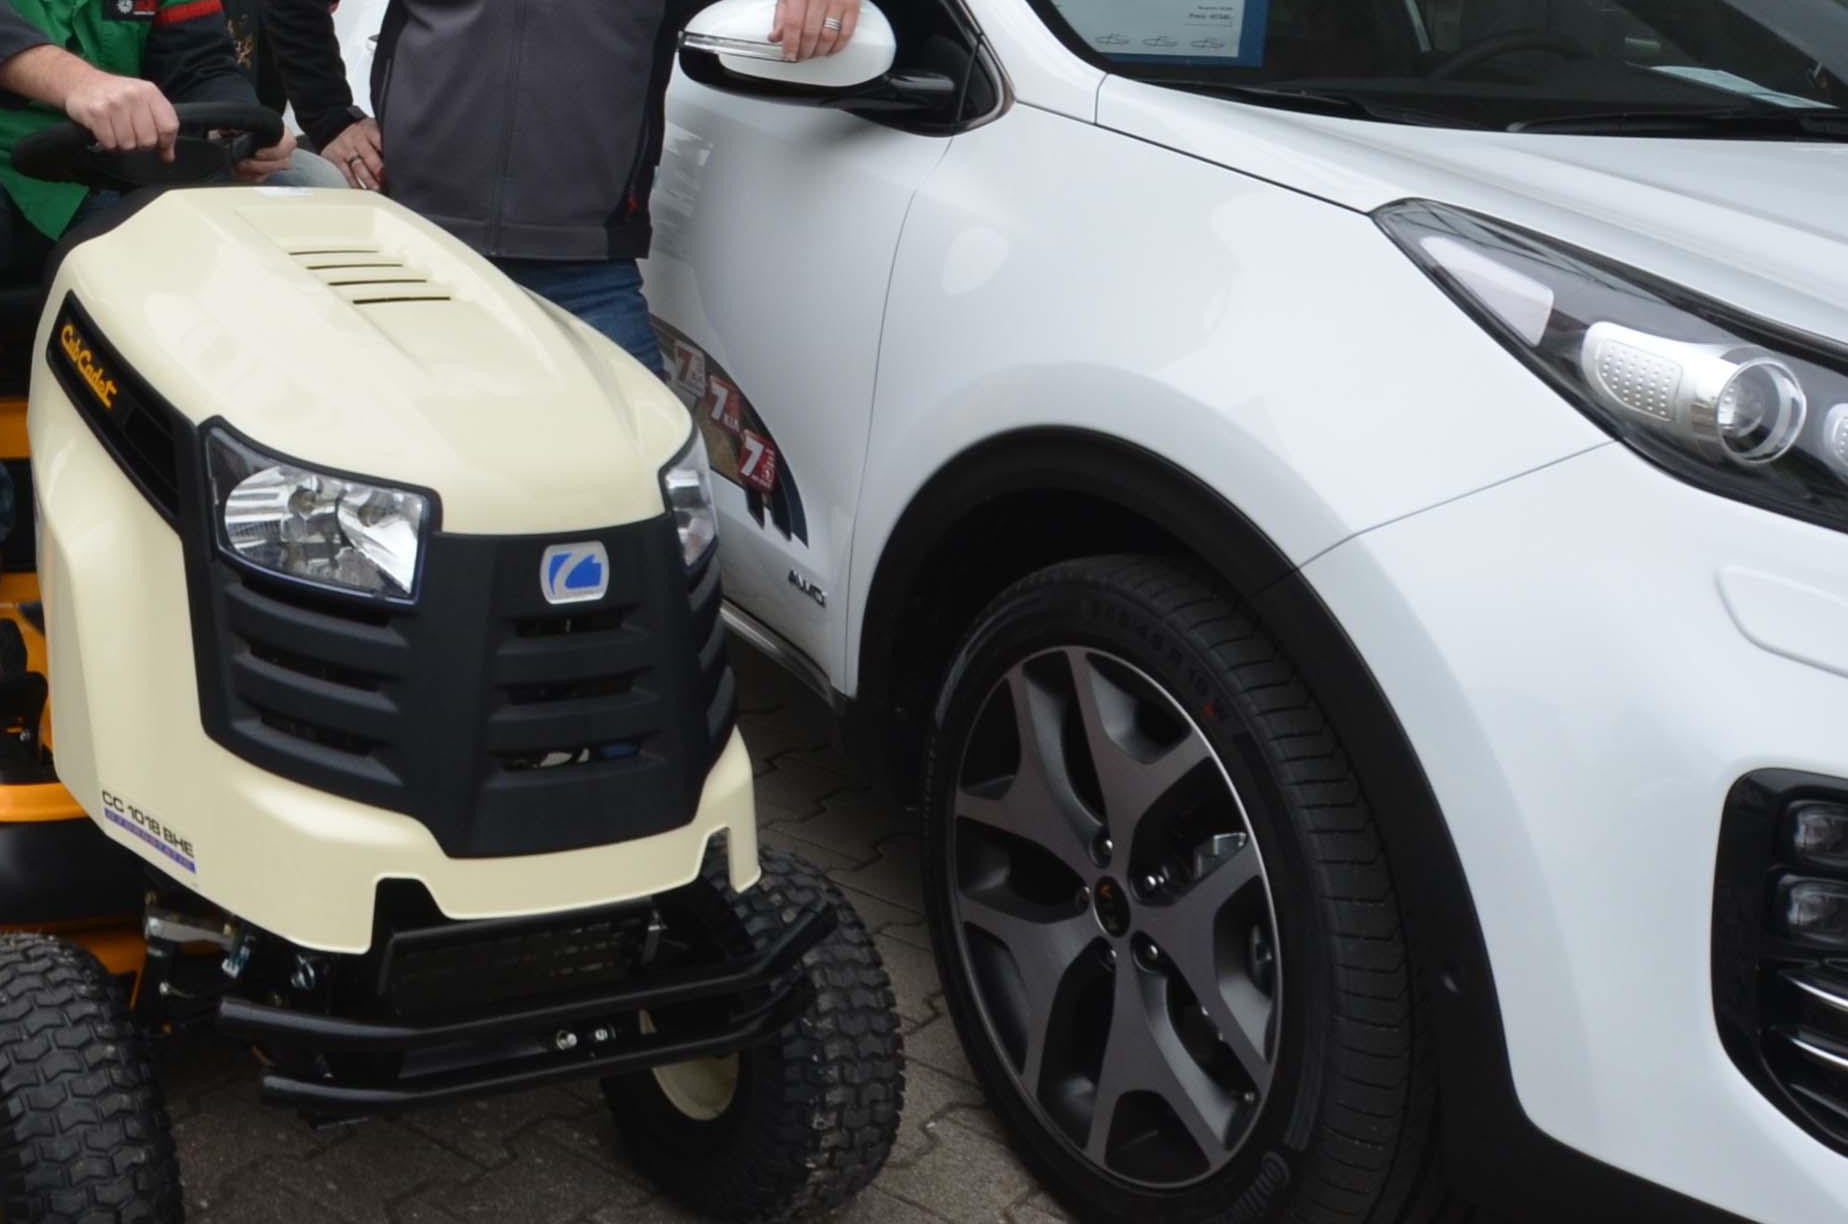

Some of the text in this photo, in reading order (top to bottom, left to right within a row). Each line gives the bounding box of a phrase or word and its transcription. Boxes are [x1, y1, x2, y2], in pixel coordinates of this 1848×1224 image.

[711, 379, 729, 420] 7
[740, 435, 765, 476] 7
[102, 789, 125, 814] CC
[128, 804, 161, 837] 1018
[163, 826, 195, 859] BHE
